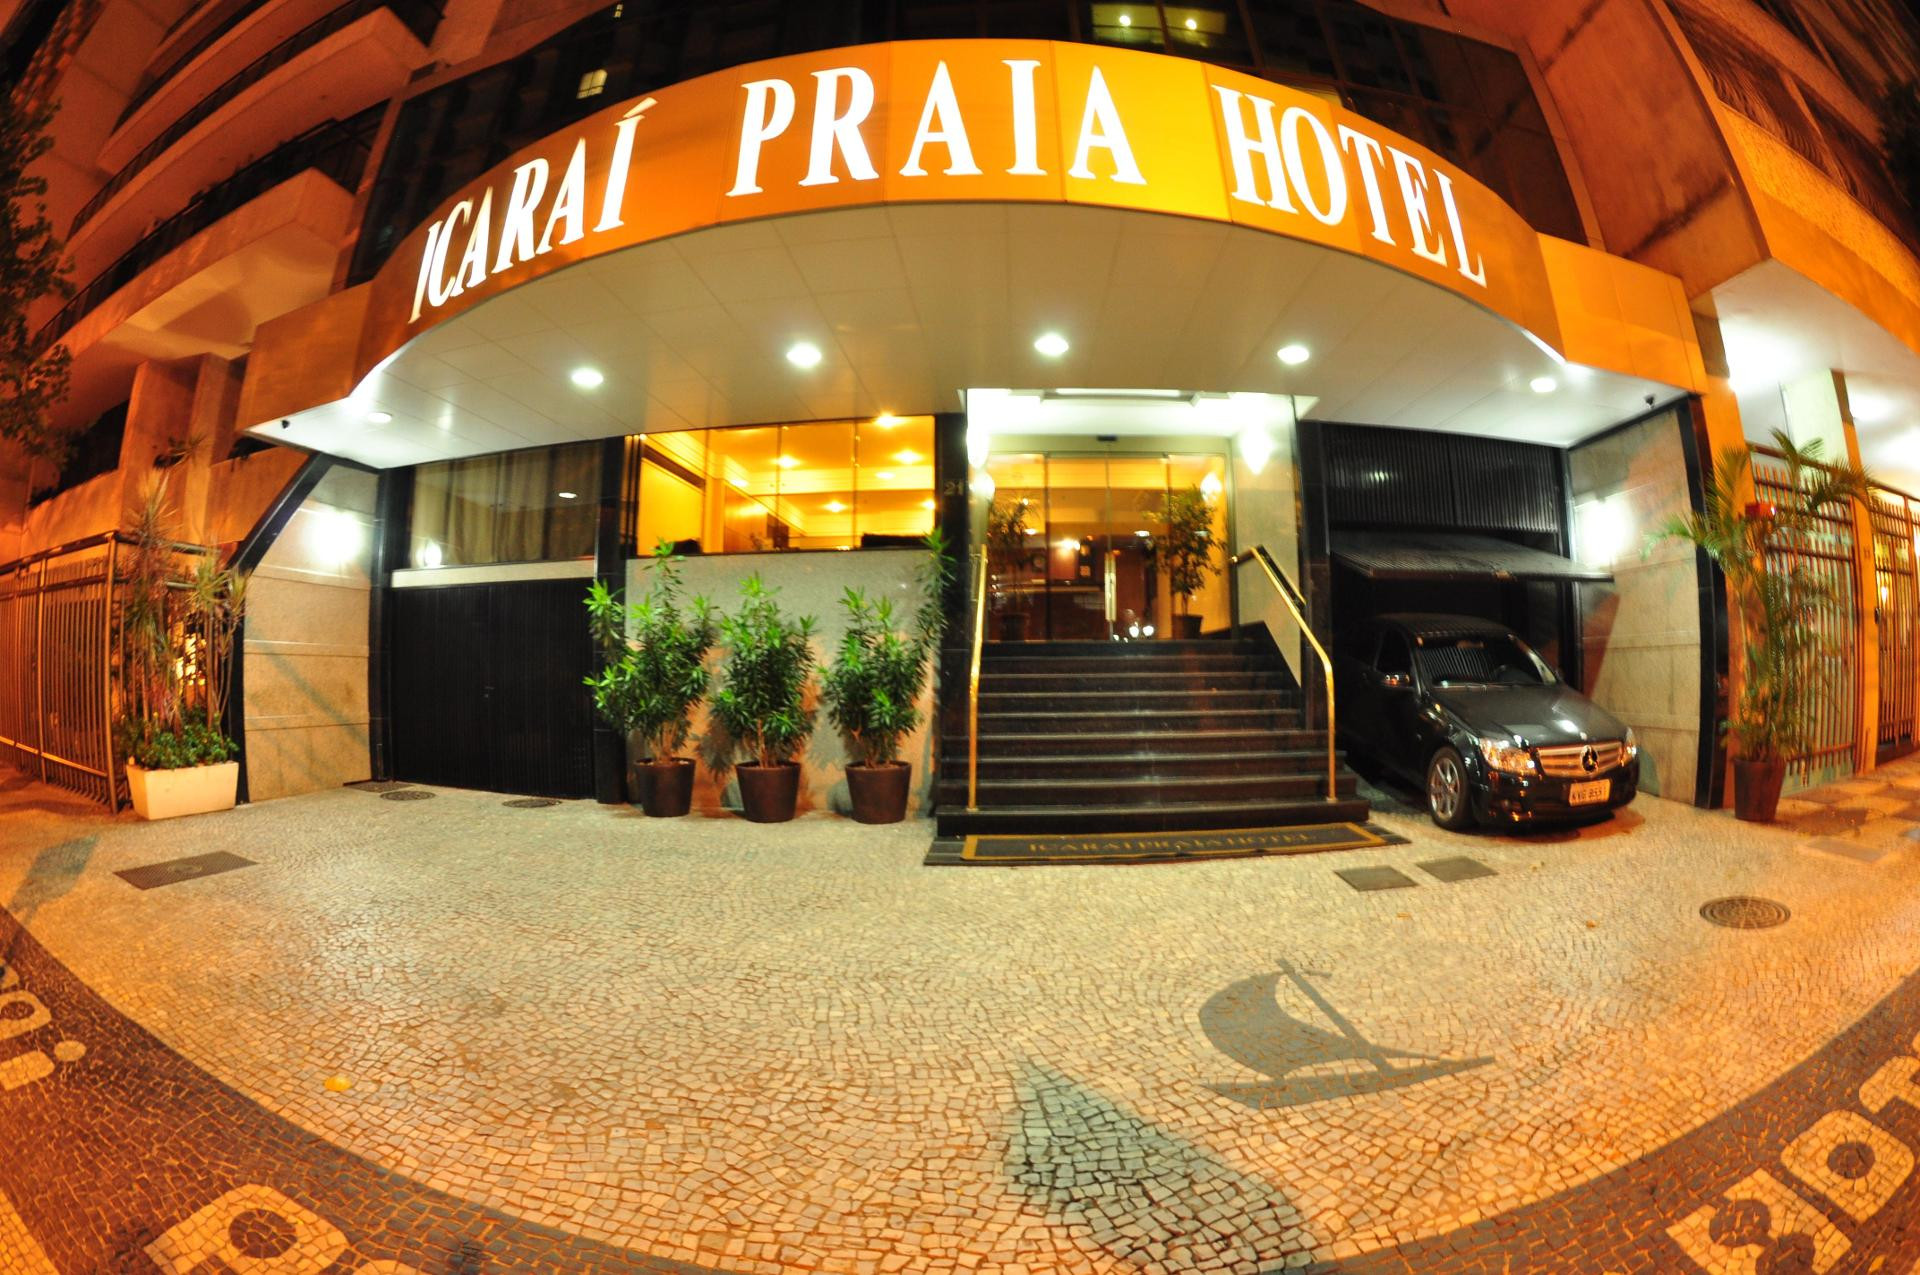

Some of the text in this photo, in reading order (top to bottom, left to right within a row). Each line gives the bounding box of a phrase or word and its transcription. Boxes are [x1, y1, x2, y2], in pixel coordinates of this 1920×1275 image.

[408, 59, 1488, 324] ICARAÍ PRAIA HOTEL
